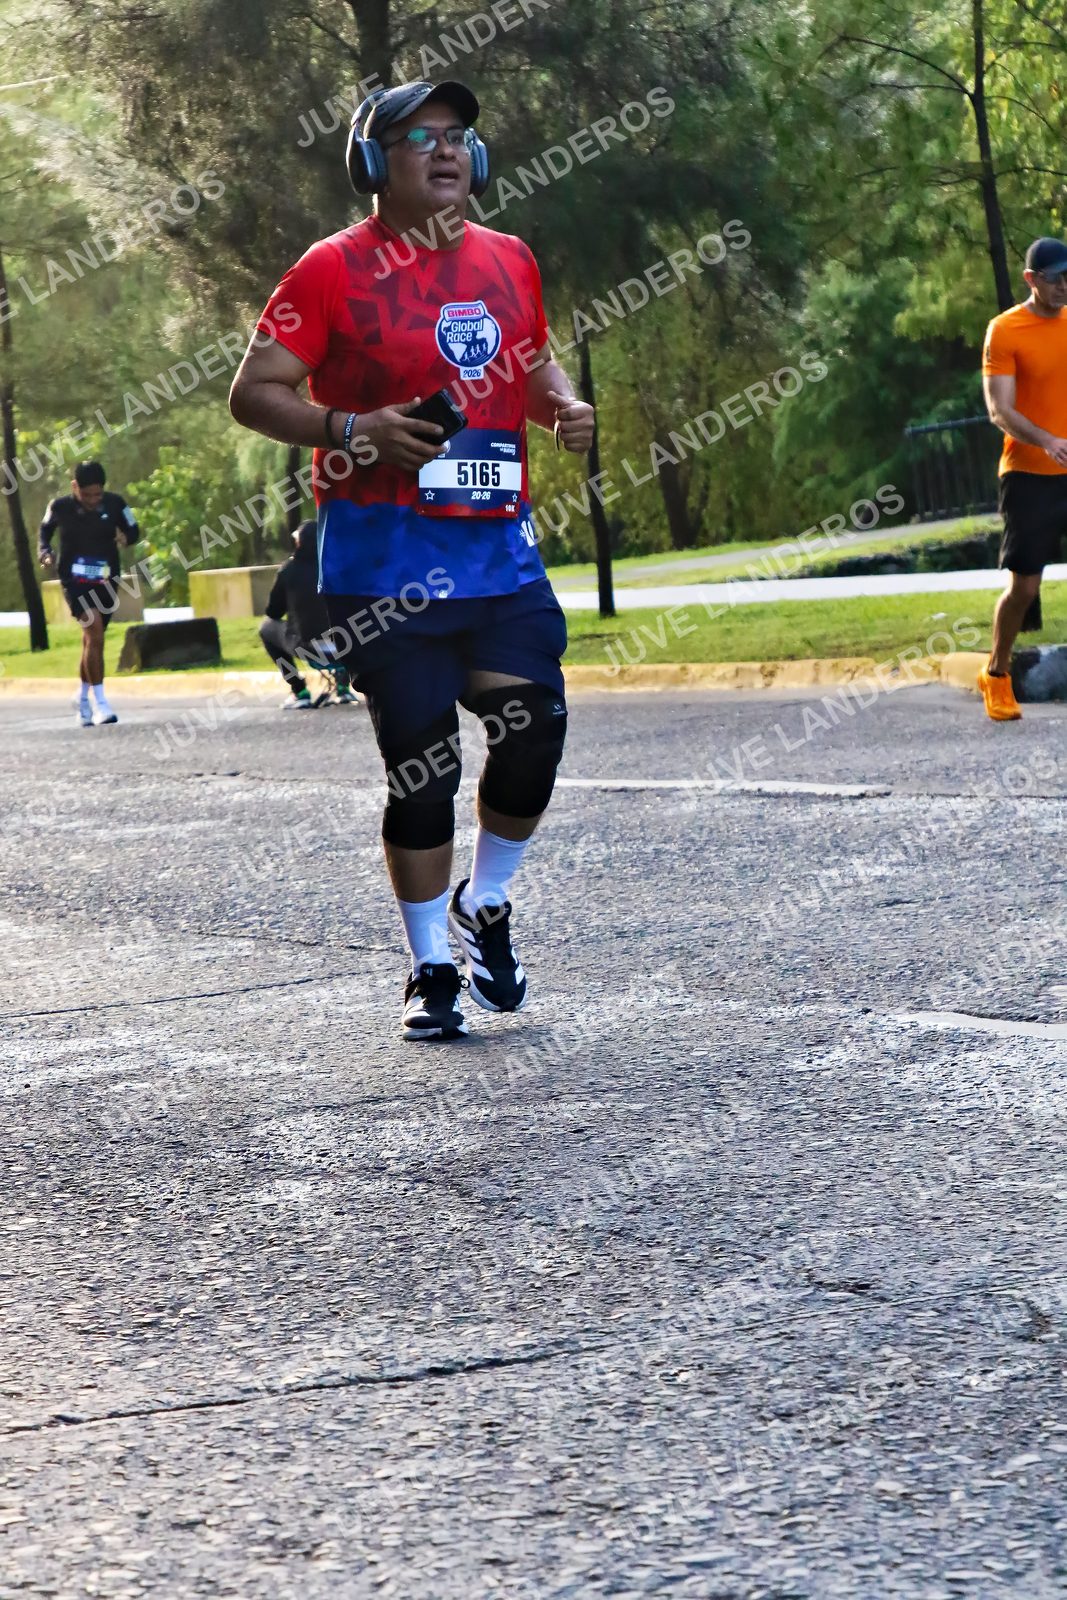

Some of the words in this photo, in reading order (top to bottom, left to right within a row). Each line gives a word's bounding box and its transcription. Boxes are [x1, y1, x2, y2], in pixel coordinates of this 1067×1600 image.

[447, 307, 481, 318] BIMBO
[451, 319, 483, 332] Global
[446, 331, 473, 343] Race
[462, 369, 482, 378] 2026
[457, 462, 501, 487] 5165
